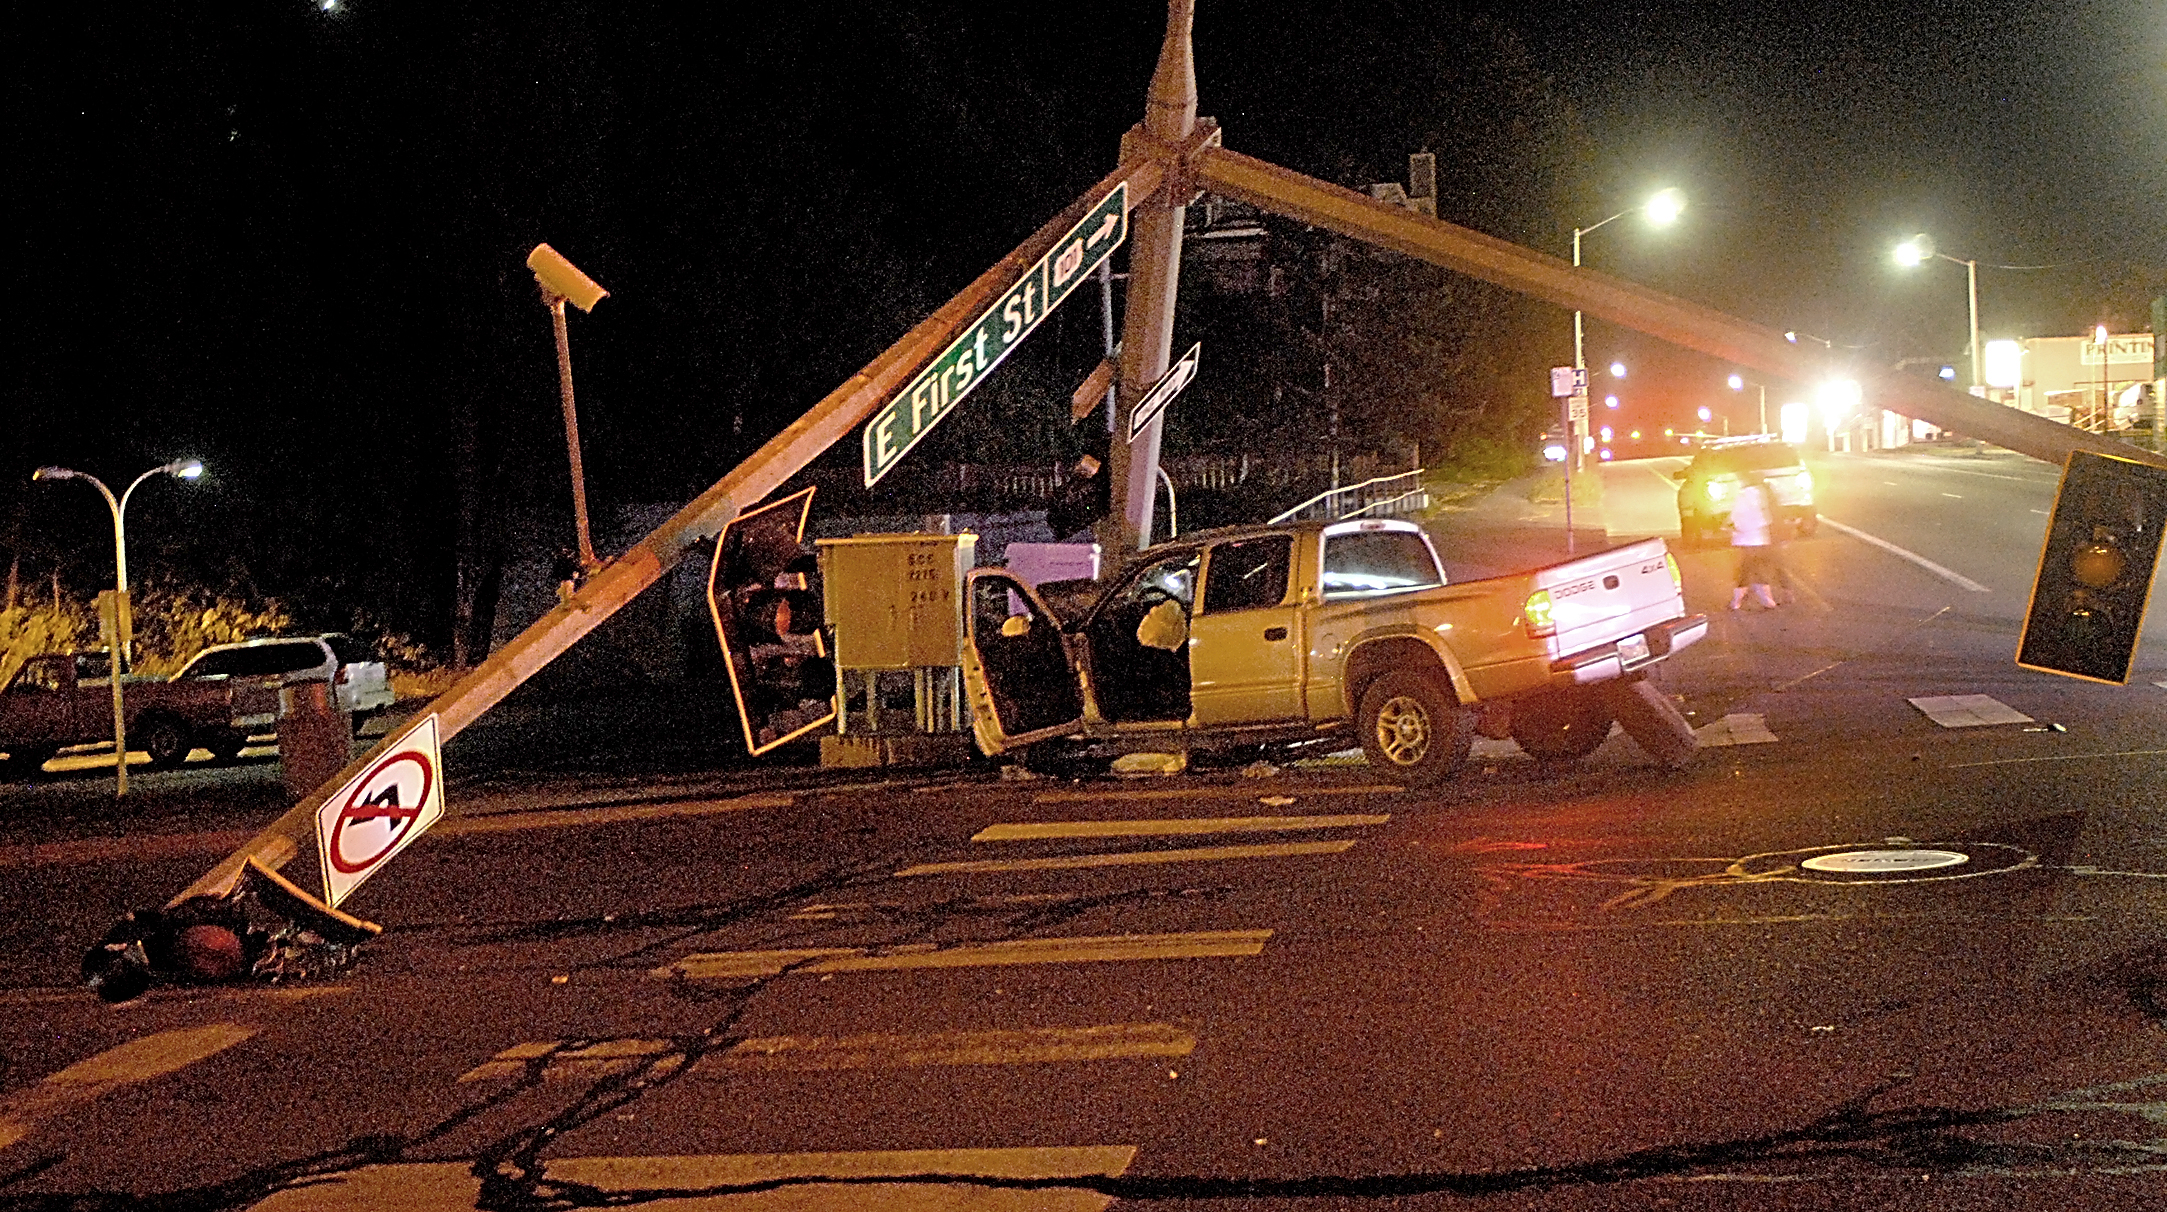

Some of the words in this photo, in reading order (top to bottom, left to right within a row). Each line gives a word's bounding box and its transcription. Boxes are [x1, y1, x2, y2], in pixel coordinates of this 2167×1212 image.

[876, 412, 897, 469] E
[911, 326, 989, 435] First
[1003, 280, 1036, 344] St
[1554, 580, 1596, 600] DODGE
